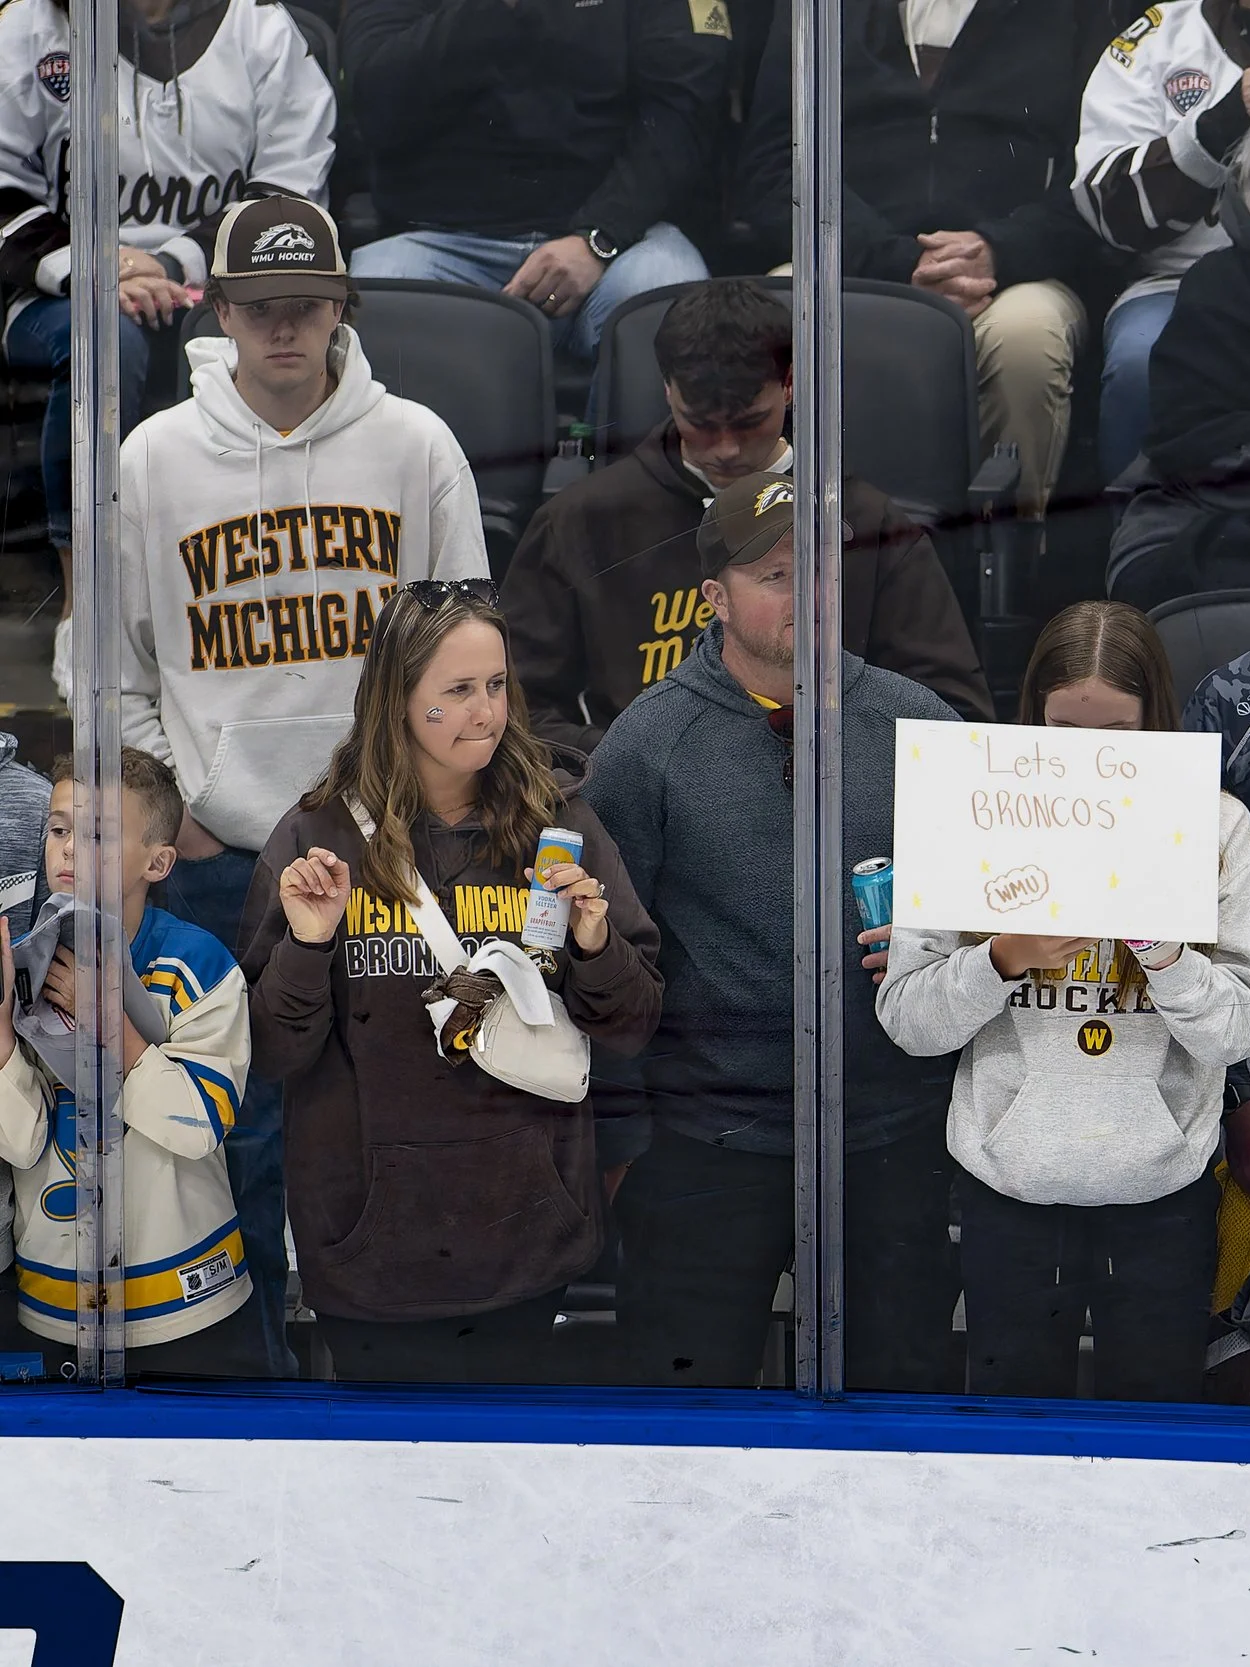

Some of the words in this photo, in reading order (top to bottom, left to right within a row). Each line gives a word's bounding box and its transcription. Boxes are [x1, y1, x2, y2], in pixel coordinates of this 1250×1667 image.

[251, 255, 275, 264] WMU
[278, 252, 316, 262] HOCKEY
[178, 503, 401, 600] WESTERN
[987, 735, 1066, 778] Lets
[1096, 745, 1137, 779] Go
[971, 790, 1115, 830] BRONCOS
[994, 874, 1041, 904] WMU
[1083, 1027, 1108, 1050] W
